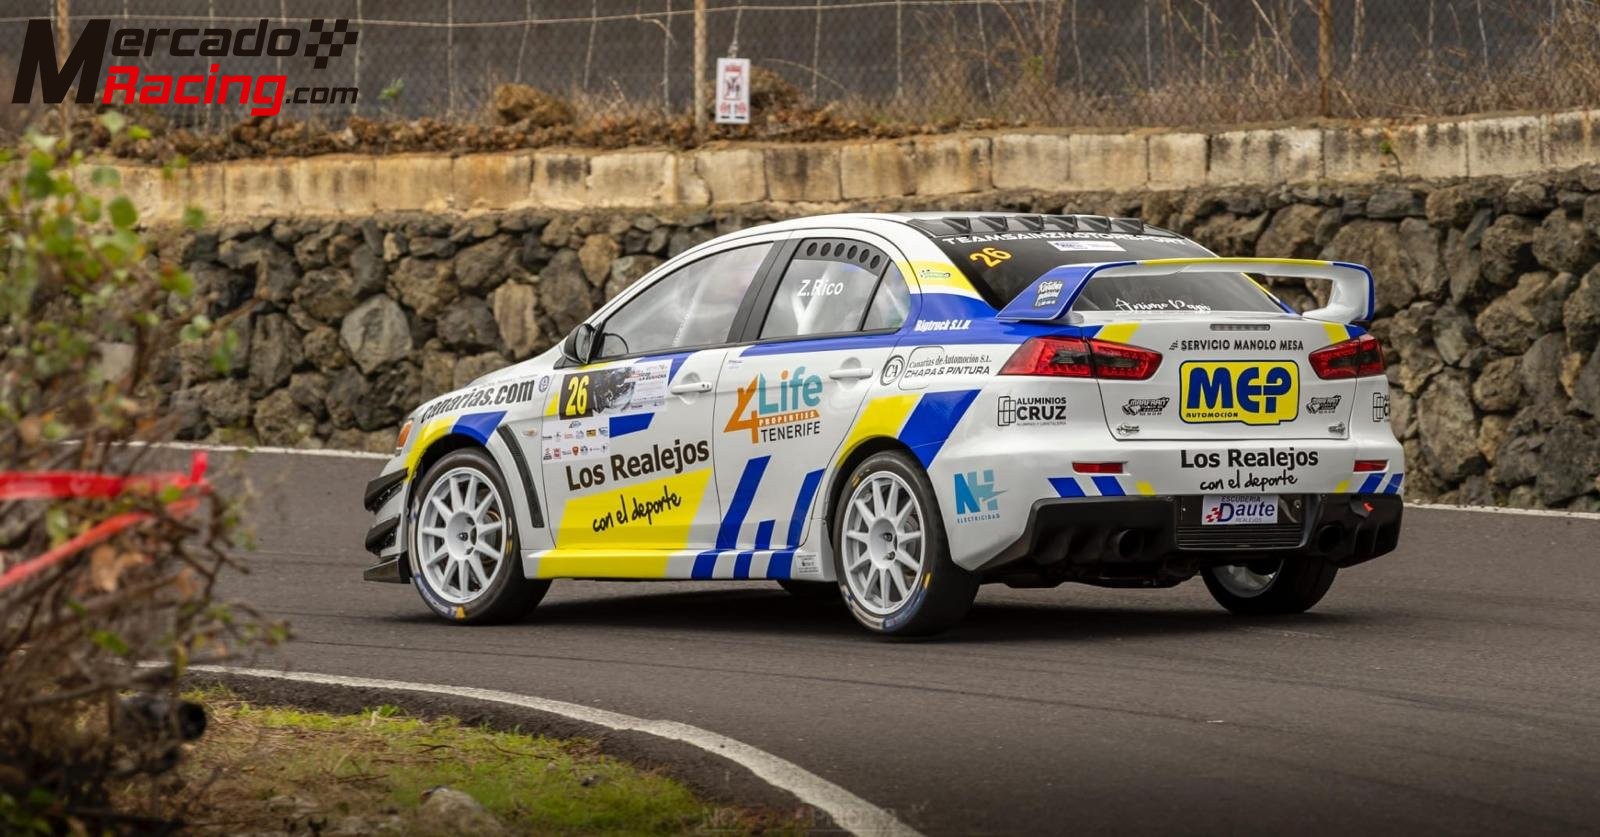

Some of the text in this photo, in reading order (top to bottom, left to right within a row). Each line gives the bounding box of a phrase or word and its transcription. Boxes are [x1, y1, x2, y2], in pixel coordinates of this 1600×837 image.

[970, 247, 1012, 268] 26
[797, 279, 844, 296] Z.Rico
[1181, 339, 1304, 351] SERVICIO MANOLO MESA
[904, 367, 937, 378] CHAPA
[945, 365, 990, 375] PINTURA
[909, 357, 935, 368] Canarias
[935, 355, 944, 366] de
[565, 375, 590, 417] 26
[1186, 367, 1292, 413] MEP
[421, 379, 535, 424] canarias.com
[1017, 397, 1067, 405] ALUMINIOS
[758, 411, 815, 426] PROPERTIES
[1016, 405, 1067, 420] CRUZ
[761, 421, 821, 443] TENERIFE
[565, 463, 606, 491] Los
[610, 439, 710, 481] Realejos
[1180, 447, 1319, 471] Los Realejos
[1199, 469, 1298, 491] con el deporte
[592, 485, 682, 532] con el deporte
[957, 513, 1000, 524] ELECTRICIDAD
[1217, 501, 1275, 522] Daute
